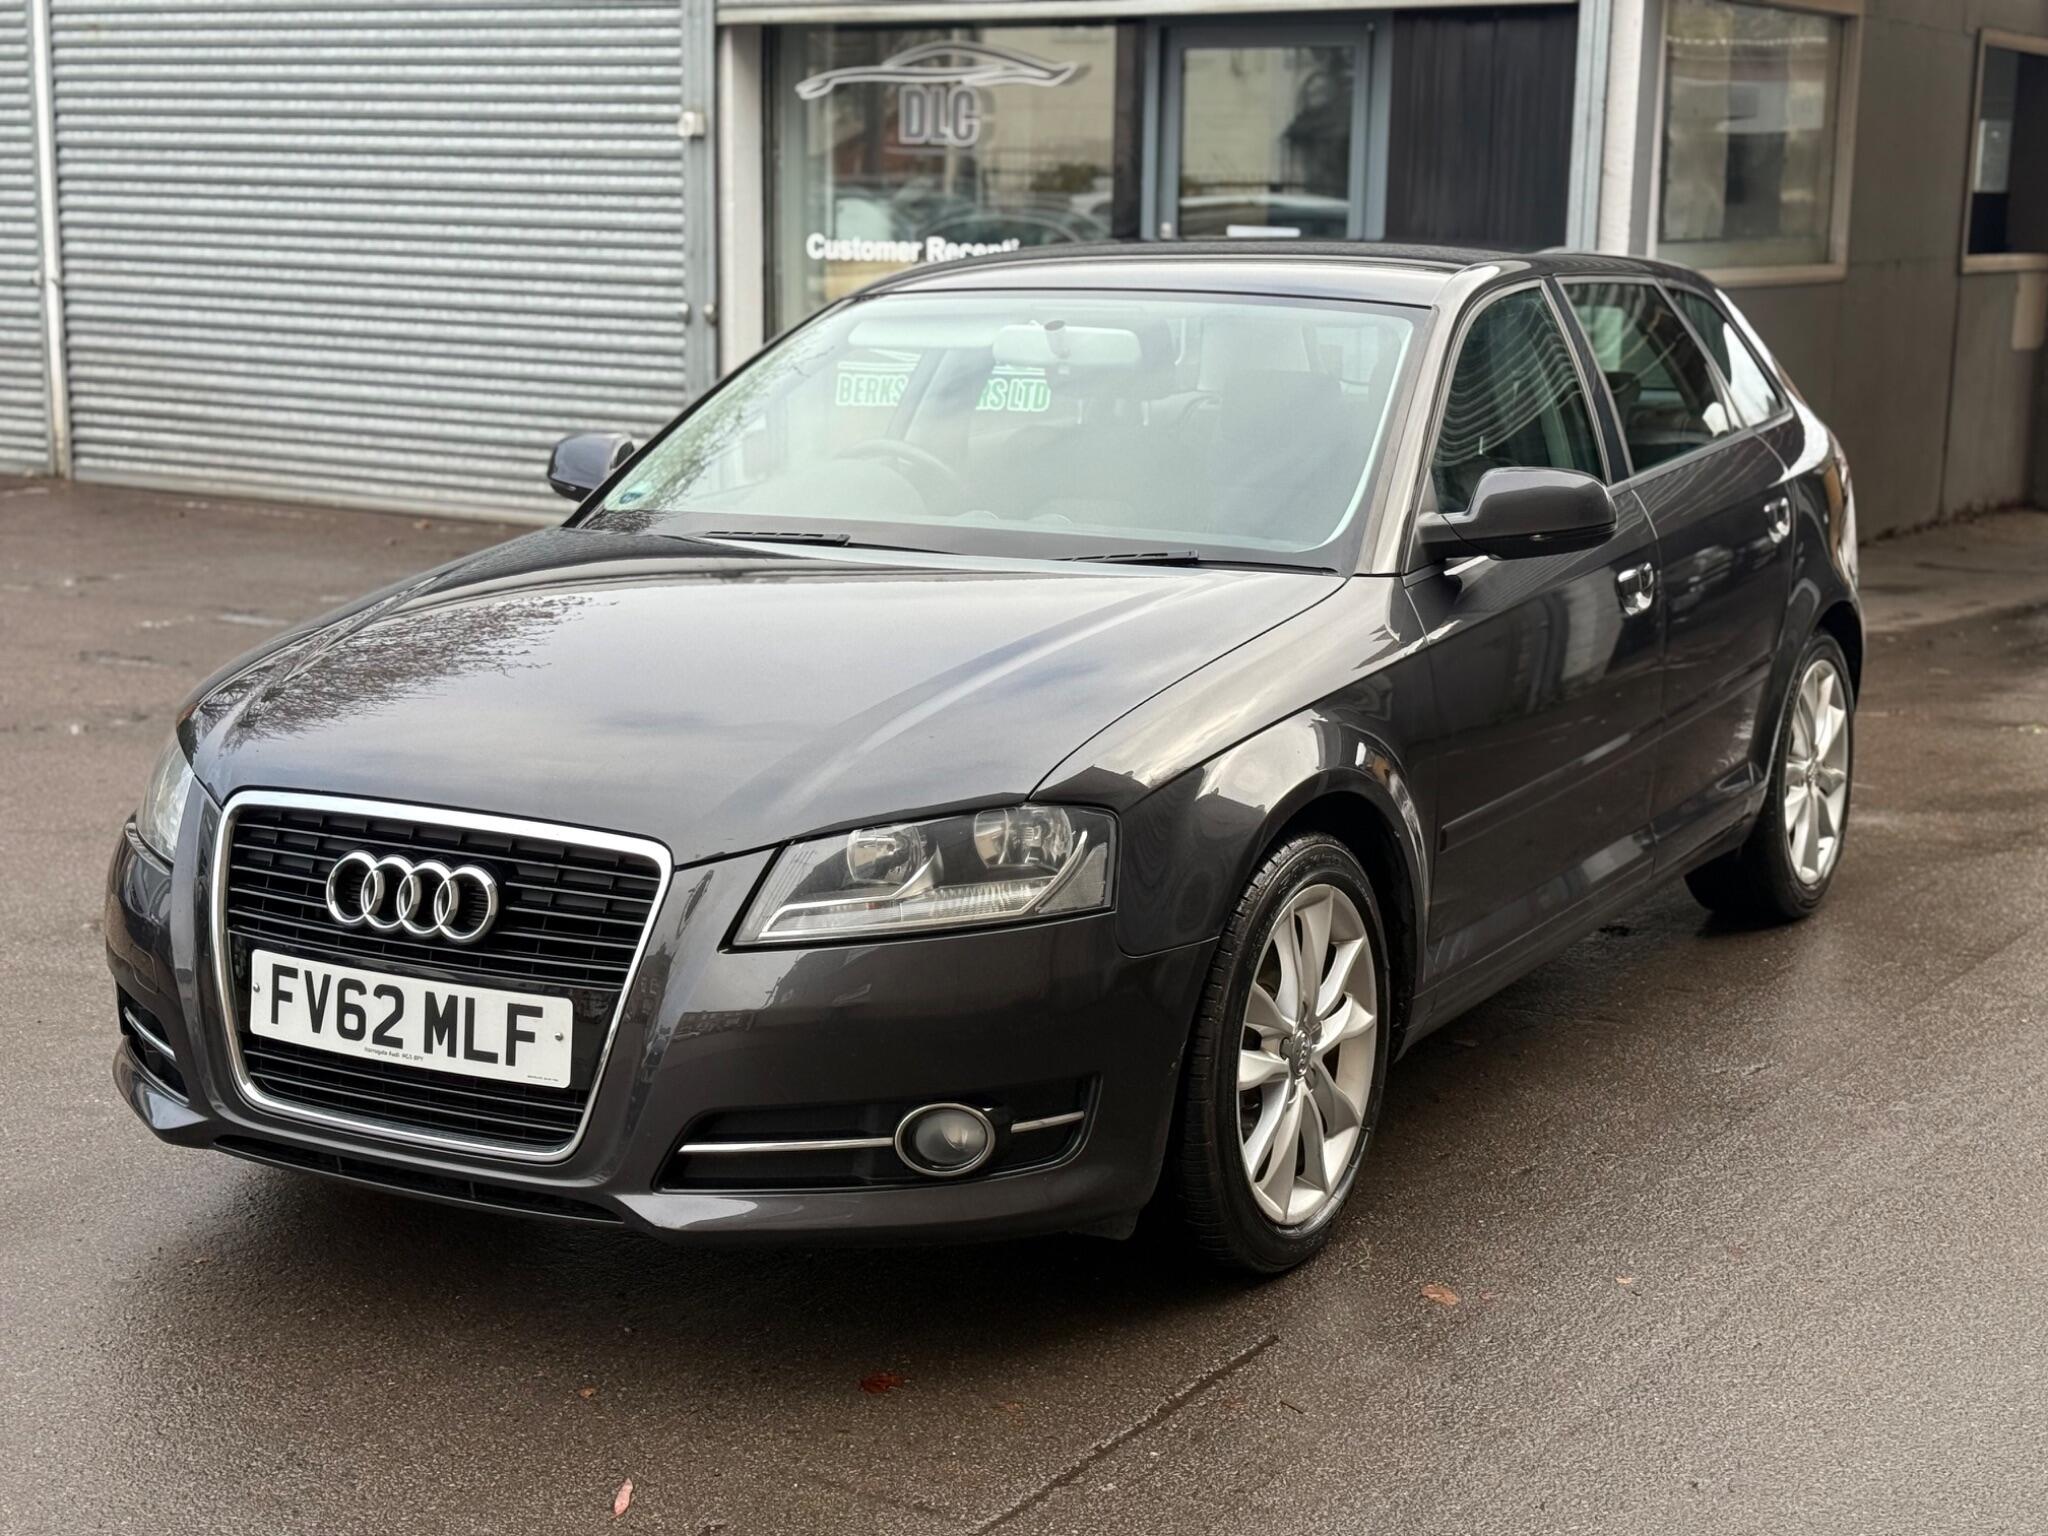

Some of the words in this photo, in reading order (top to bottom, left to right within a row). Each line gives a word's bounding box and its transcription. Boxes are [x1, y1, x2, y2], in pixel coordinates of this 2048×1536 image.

[898, 85, 980, 146] DLC
[806, 232, 923, 262] Customer
[270, 963, 405, 1050] FV62
[423, 991, 544, 1067] MLF
